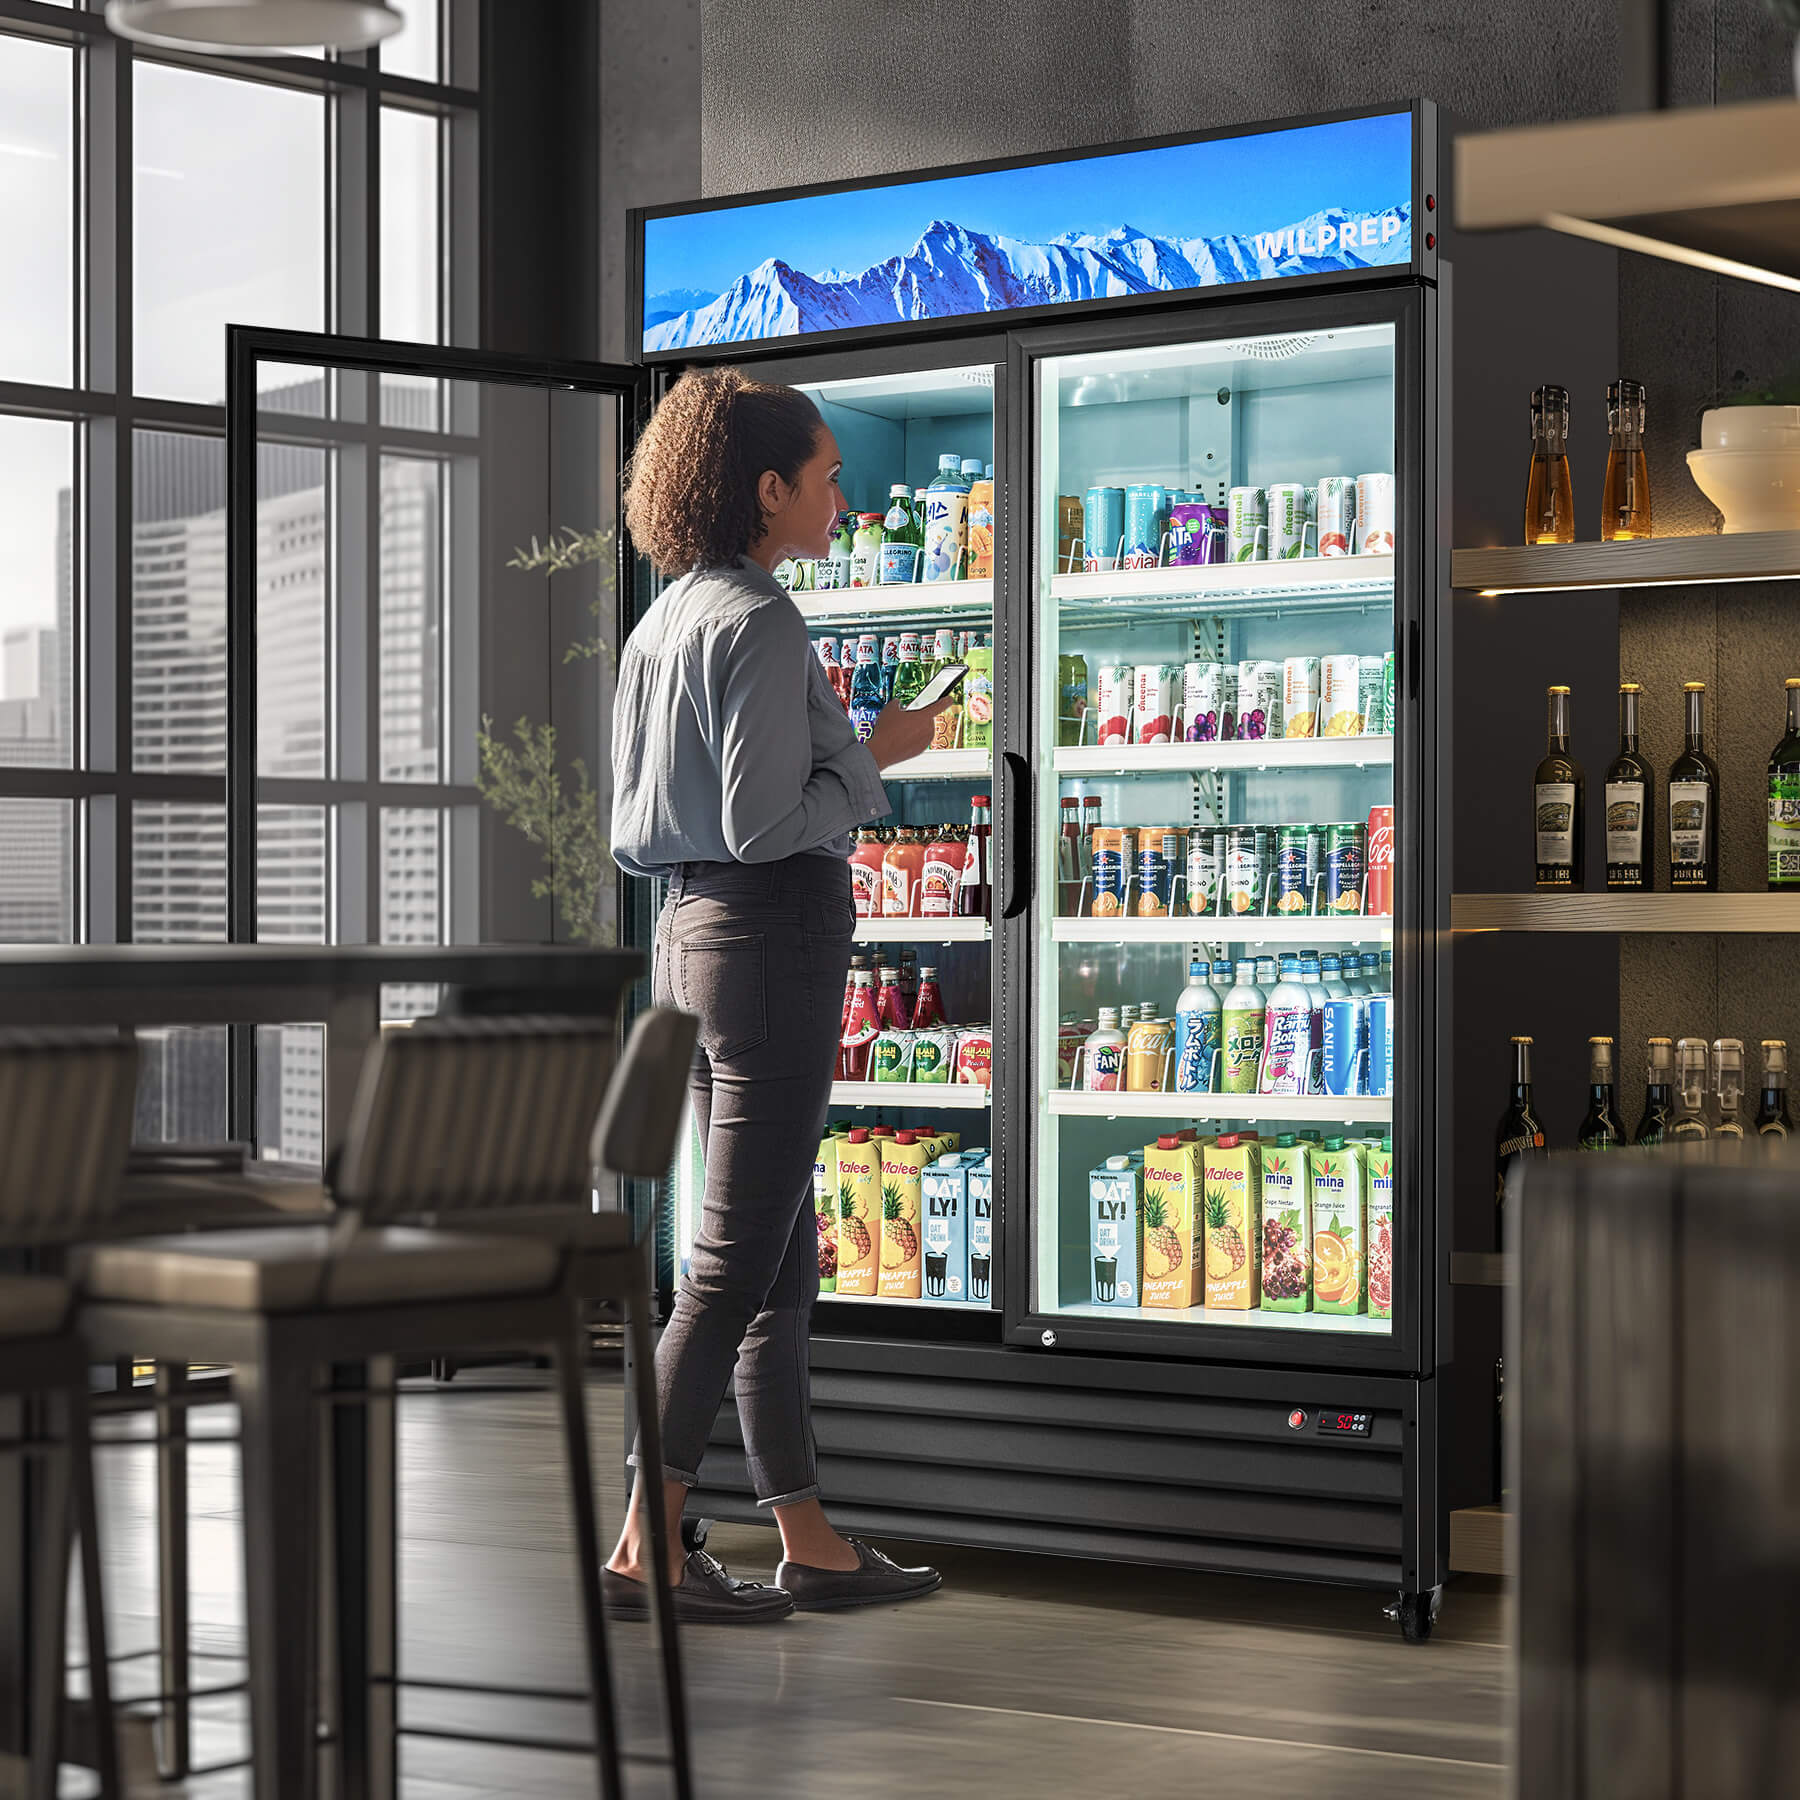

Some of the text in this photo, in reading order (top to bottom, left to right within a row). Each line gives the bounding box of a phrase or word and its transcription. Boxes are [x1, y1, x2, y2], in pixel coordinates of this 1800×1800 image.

[1255, 216, 1401, 260] WILPREP
[1324, 1007, 1334, 1072] SANLIN
[1265, 1172, 1293, 1185] mina
[1315, 1175, 1344, 1188] mina
[929, 1197, 957, 1217] LY!
[1098, 1200, 1127, 1221] LY!
[1336, 1414, 1353, 1430] 50
